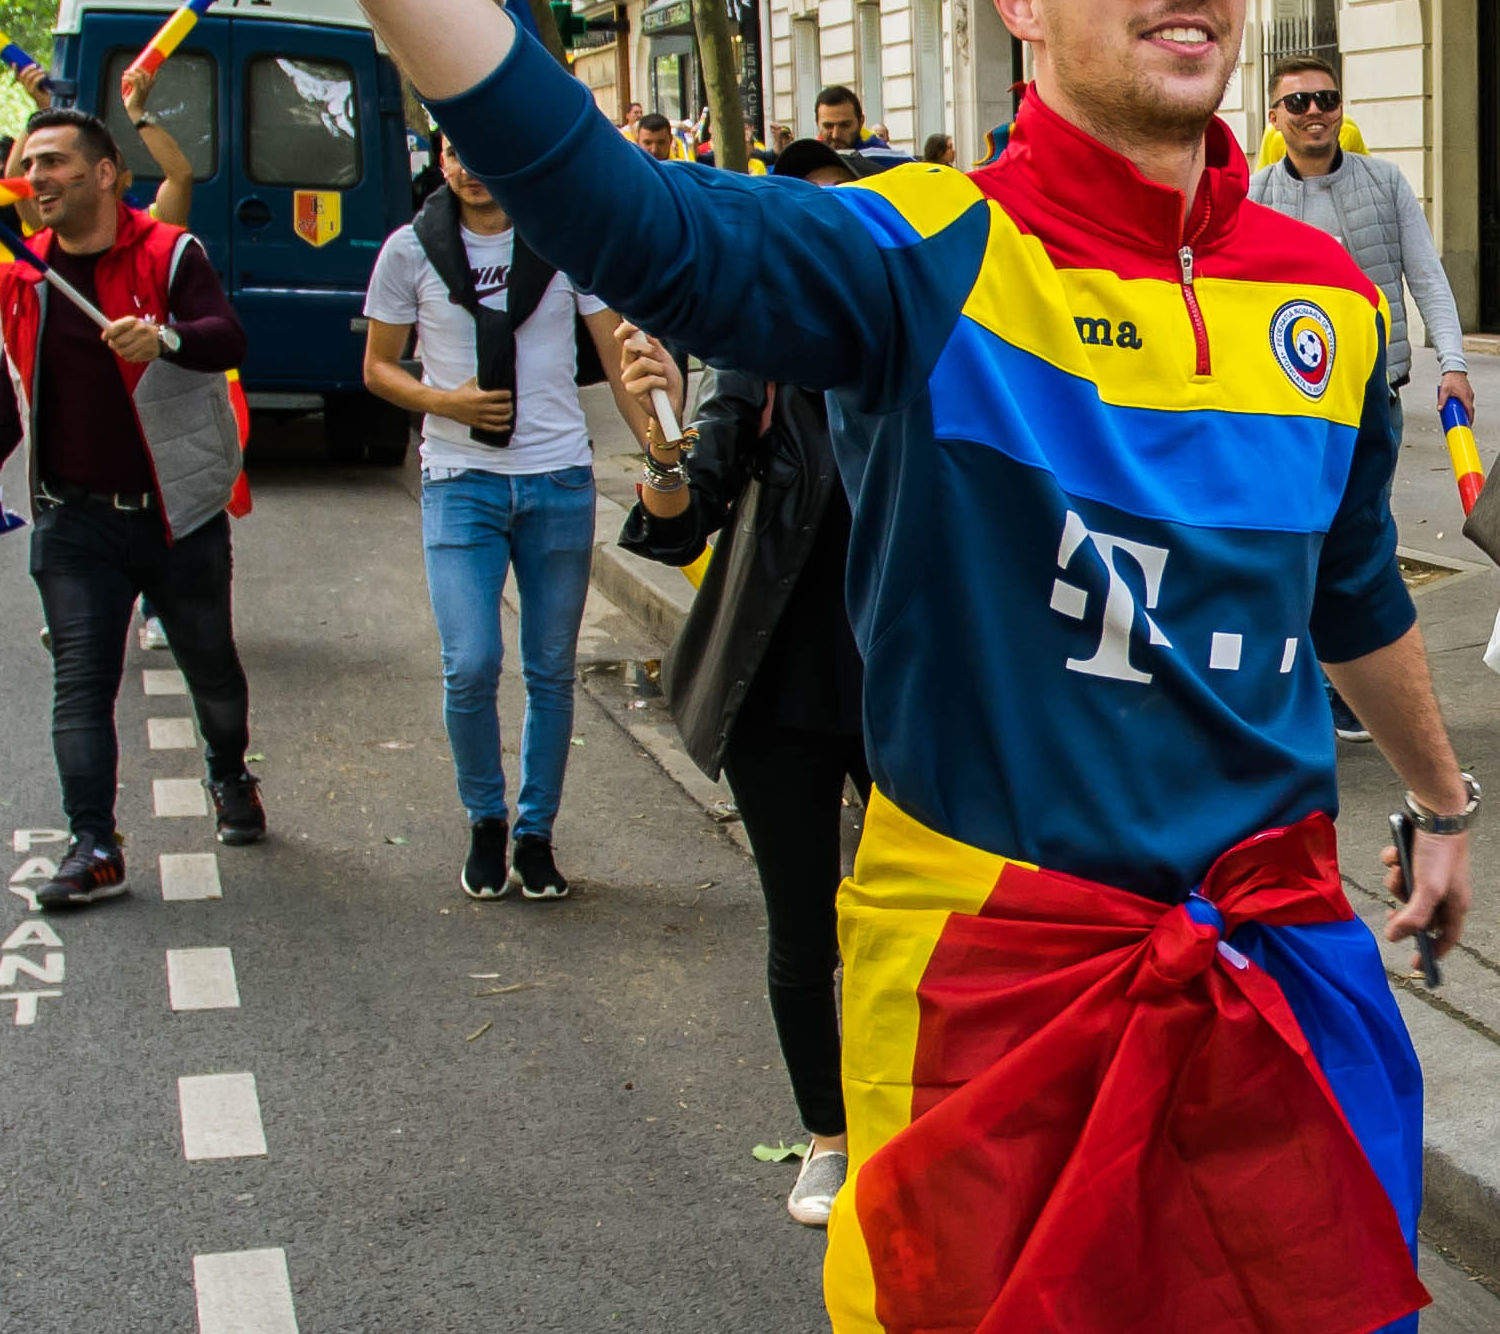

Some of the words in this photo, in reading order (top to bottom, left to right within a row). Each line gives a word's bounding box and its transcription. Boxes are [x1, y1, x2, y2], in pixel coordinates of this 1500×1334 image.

[746, 43, 757, 116] ESPACE
[472, 265, 510, 285] NIK
[1073, 316, 1142, 350] ma
